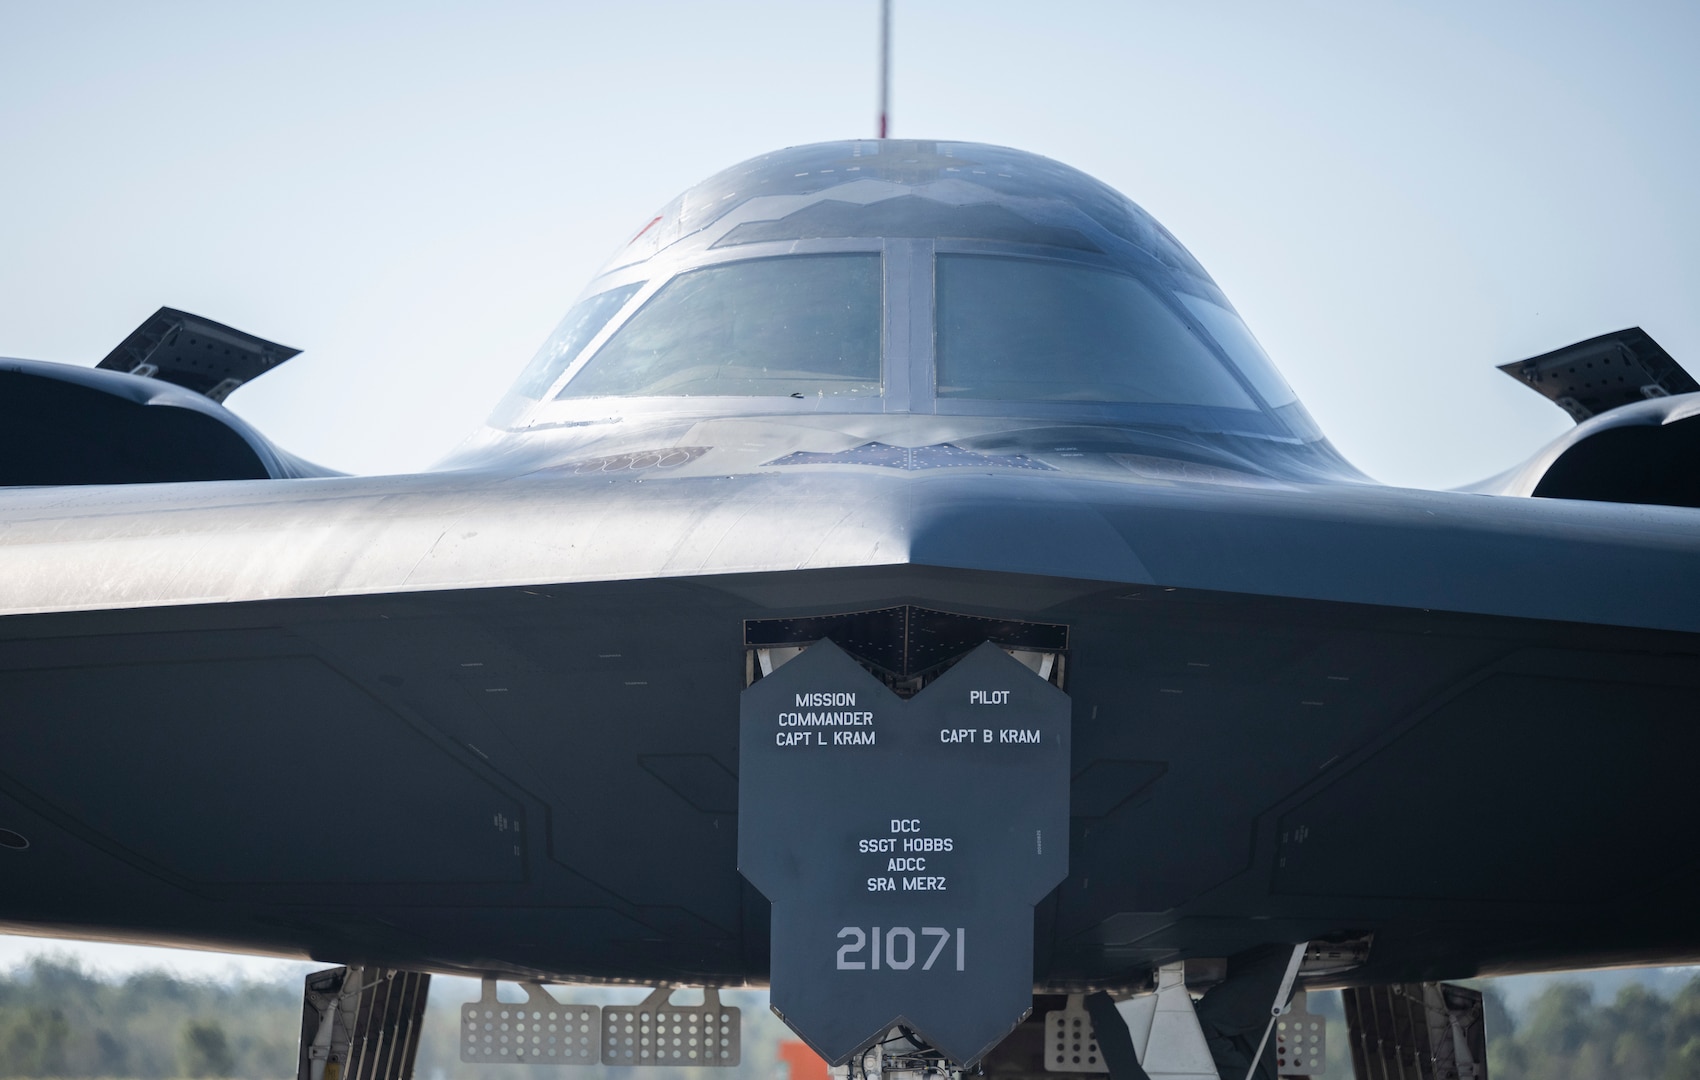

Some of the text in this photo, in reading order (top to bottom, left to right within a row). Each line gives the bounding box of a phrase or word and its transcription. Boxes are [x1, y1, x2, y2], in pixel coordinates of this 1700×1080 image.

[795, 692, 856, 707] MISSION
[970, 690, 1010, 705] PILOT
[778, 711, 873, 727] COMMANDER
[776, 731, 876, 746] CAPT L KRAM
[940, 729, 1041, 744] CAPT B KRAM
[890, 819, 921, 833] DCC
[858, 838, 954, 853] SSGT HOBBS
[887, 857, 926, 872] ADCC
[867, 876, 947, 892] SRA MERZ
[836, 926, 965, 972] 21071
